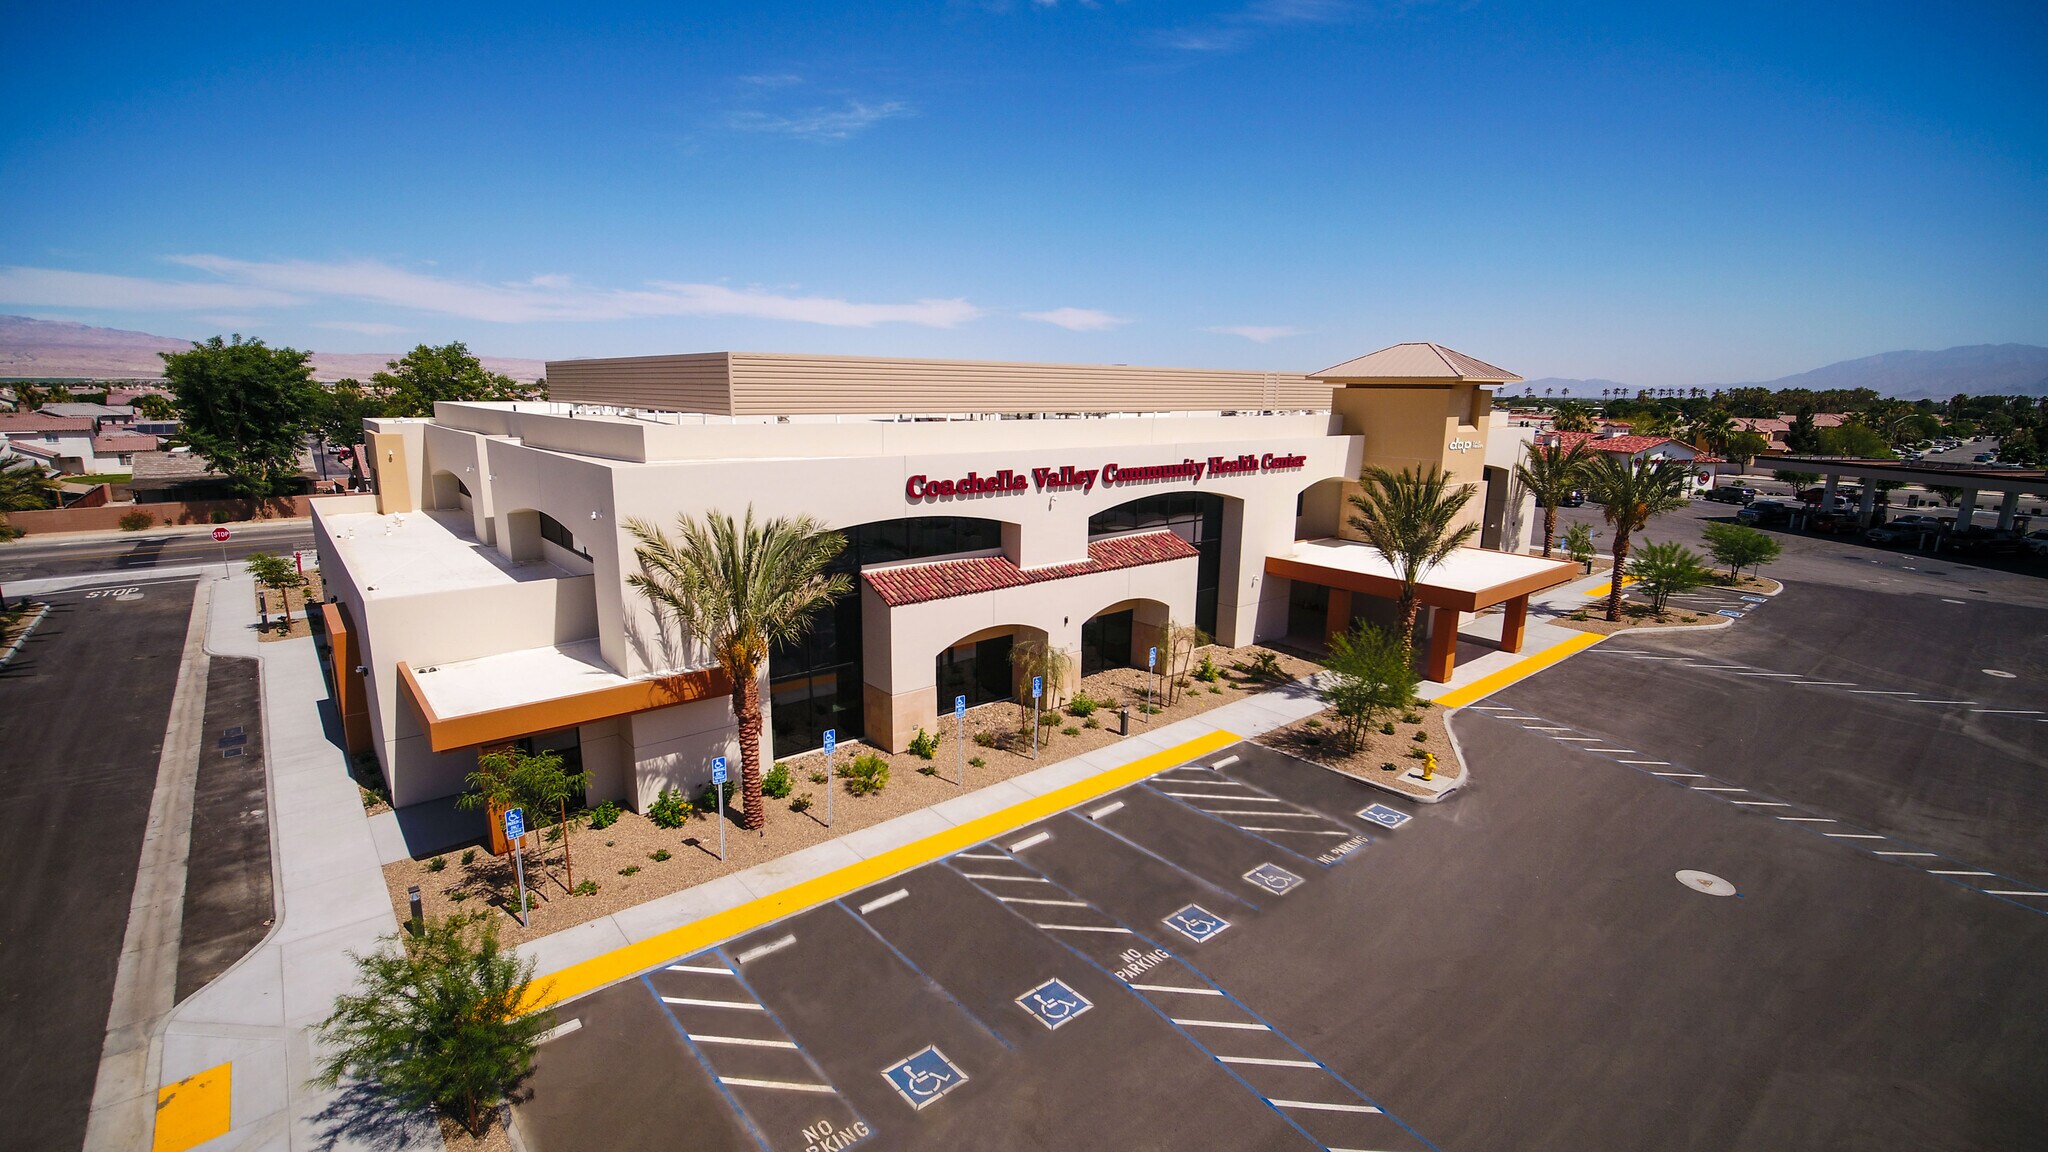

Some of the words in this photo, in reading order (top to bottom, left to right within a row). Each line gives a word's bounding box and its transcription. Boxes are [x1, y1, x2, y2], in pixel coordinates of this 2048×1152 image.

[906, 470, 1028, 499] Coachella
[1032, 465, 1099, 490] Valley
[1102, 459, 1206, 480] Community
[1208, 454, 1260, 475] Health
[1262, 453, 1307, 470] Center
[85, 587, 140, 599] STOP
[1316, 854, 1336, 865] NO
[1330, 835, 1369, 857] PARKING
[1114, 948, 1170, 982] PARKING
[1119, 948, 1142, 964] NO
[802, 1120, 833, 1144] NO
